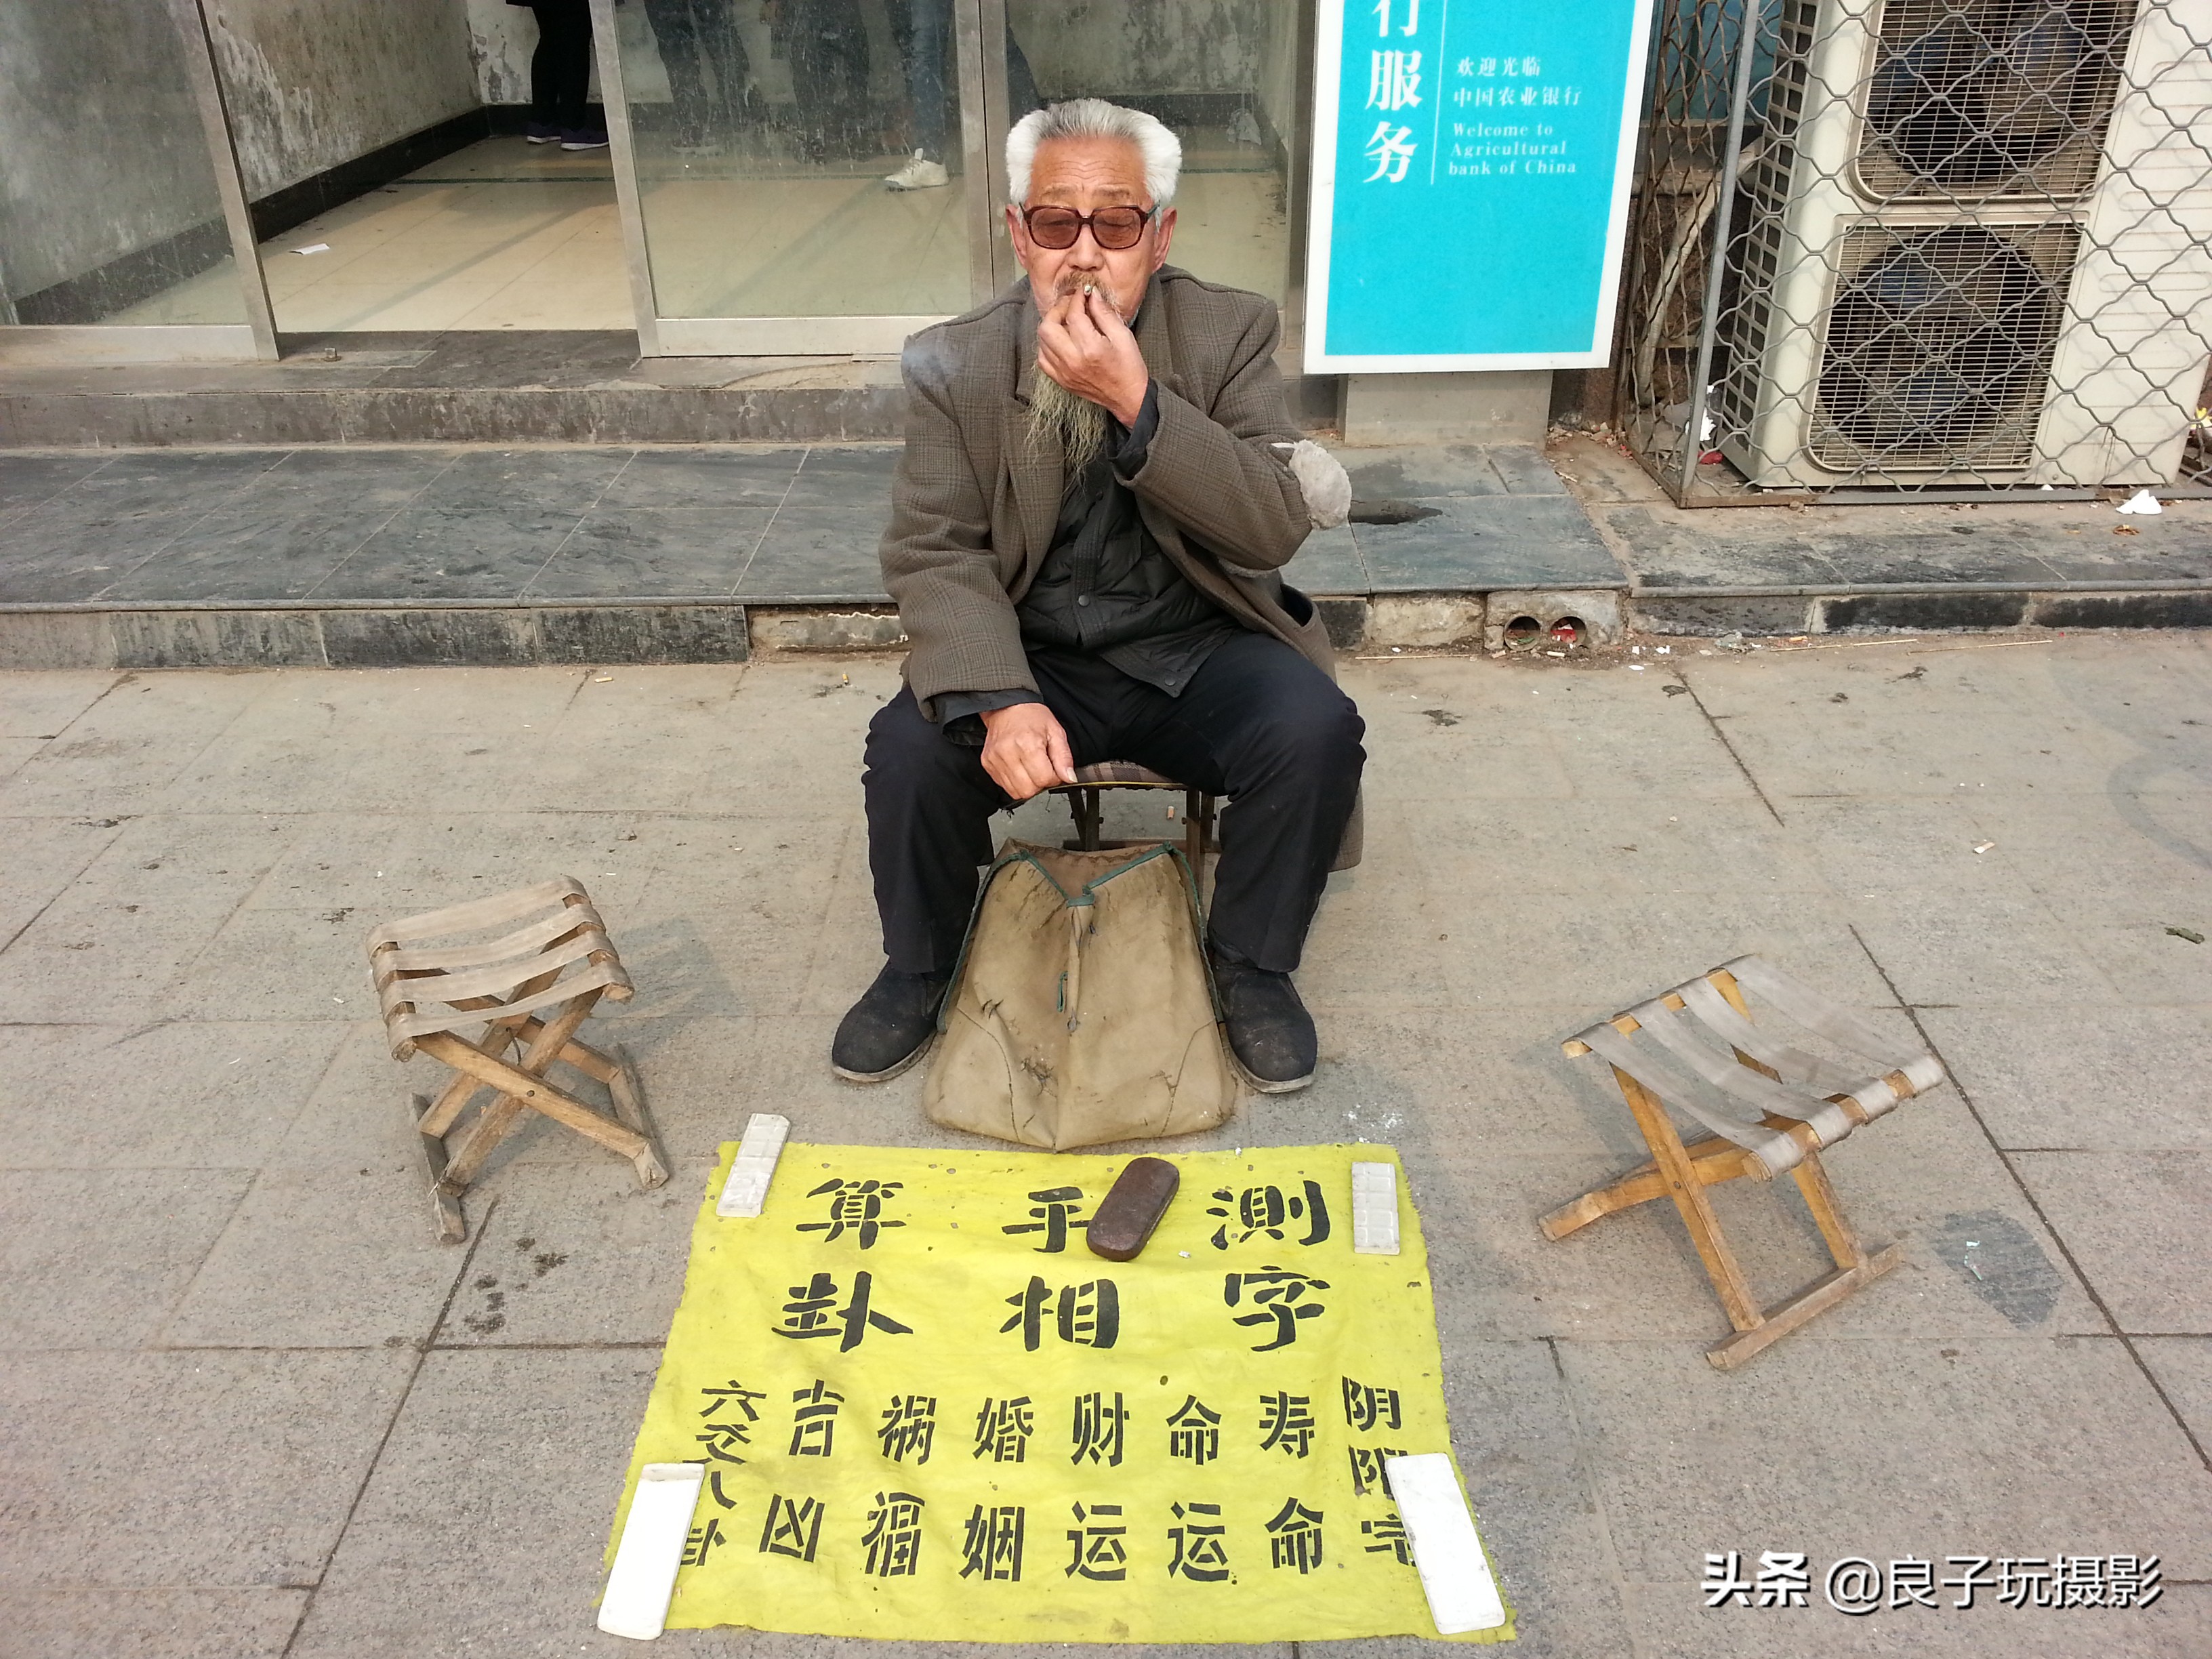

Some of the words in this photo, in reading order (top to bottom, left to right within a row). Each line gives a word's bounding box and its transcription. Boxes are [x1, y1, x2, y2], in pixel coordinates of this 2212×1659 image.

[1457, 56, 1541, 77] 欢迎光临
[1453, 85, 1582, 108] 中国农业银行
[1453, 123, 1528, 137] Welcome
[1536, 123, 1553, 136] to
[1450, 140, 1566, 158] Agricultural
[1448, 161, 1492, 176] bank
[1499, 161, 1517, 175] of
[1525, 159, 1576, 174] China
